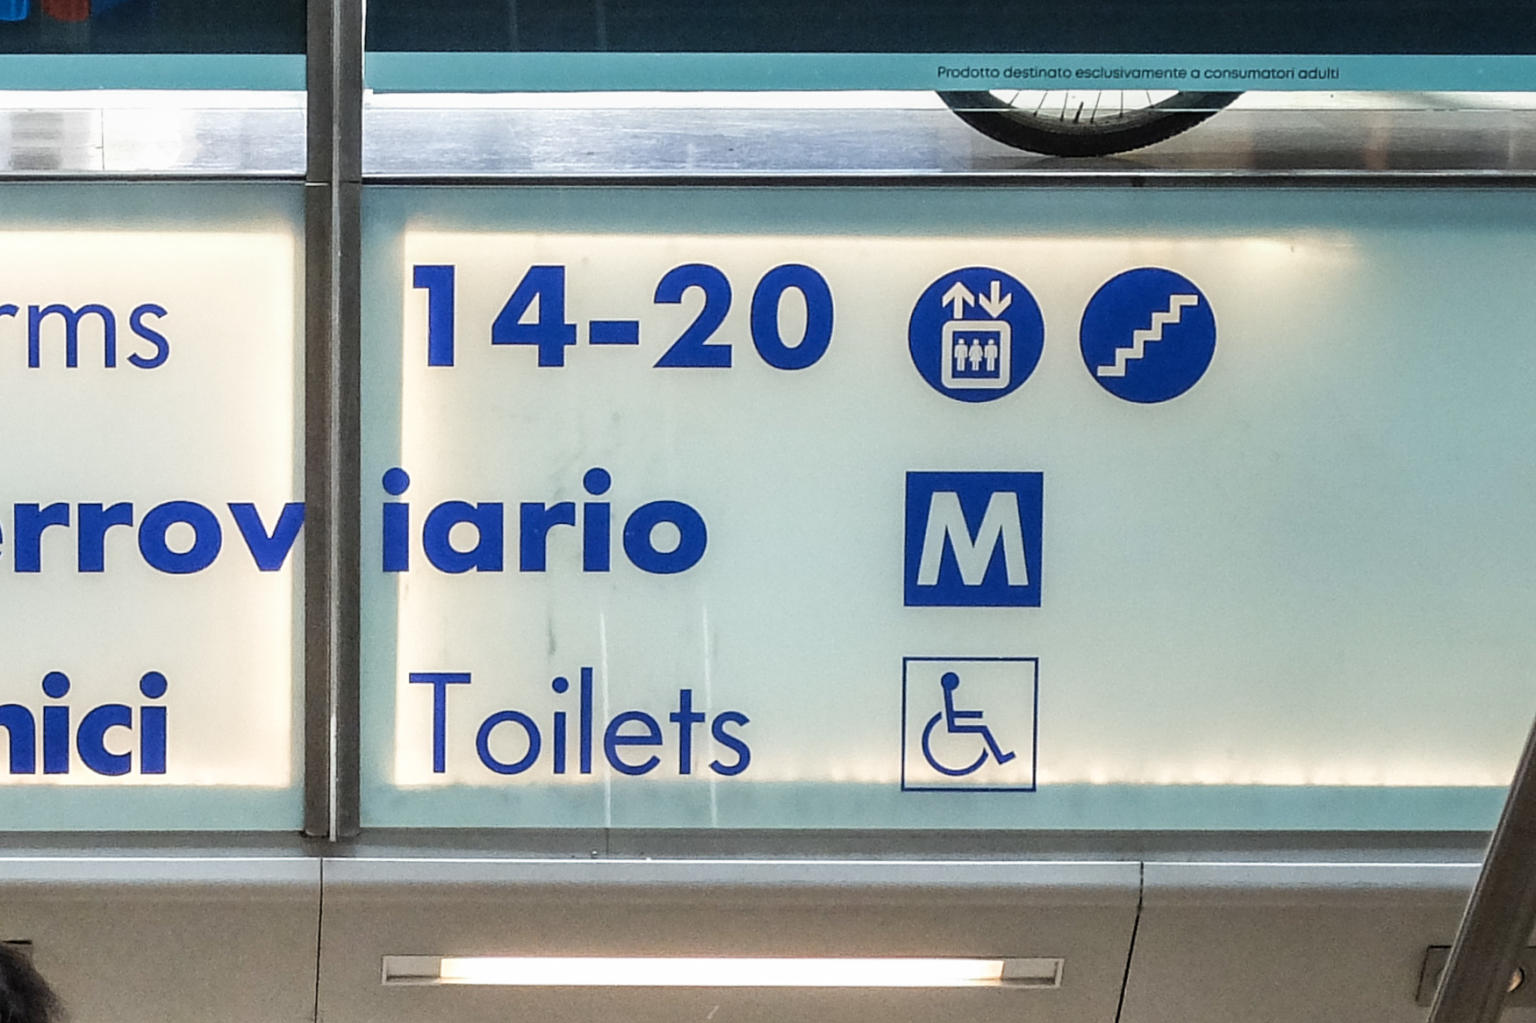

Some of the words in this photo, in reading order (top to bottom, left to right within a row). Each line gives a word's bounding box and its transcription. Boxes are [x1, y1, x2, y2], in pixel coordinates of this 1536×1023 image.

[937, 65, 1000, 79] Prodotto
[1003, 66, 1072, 79] destinato
[1074, 66, 1188, 79] esclusivamente
[1190, 69, 1201, 80] a
[1203, 67, 1295, 80] consumatori
[1297, 66, 1340, 80] adulti
[414, 264, 834, 370] 14-20
[410, 666, 750, 775] Toilets
